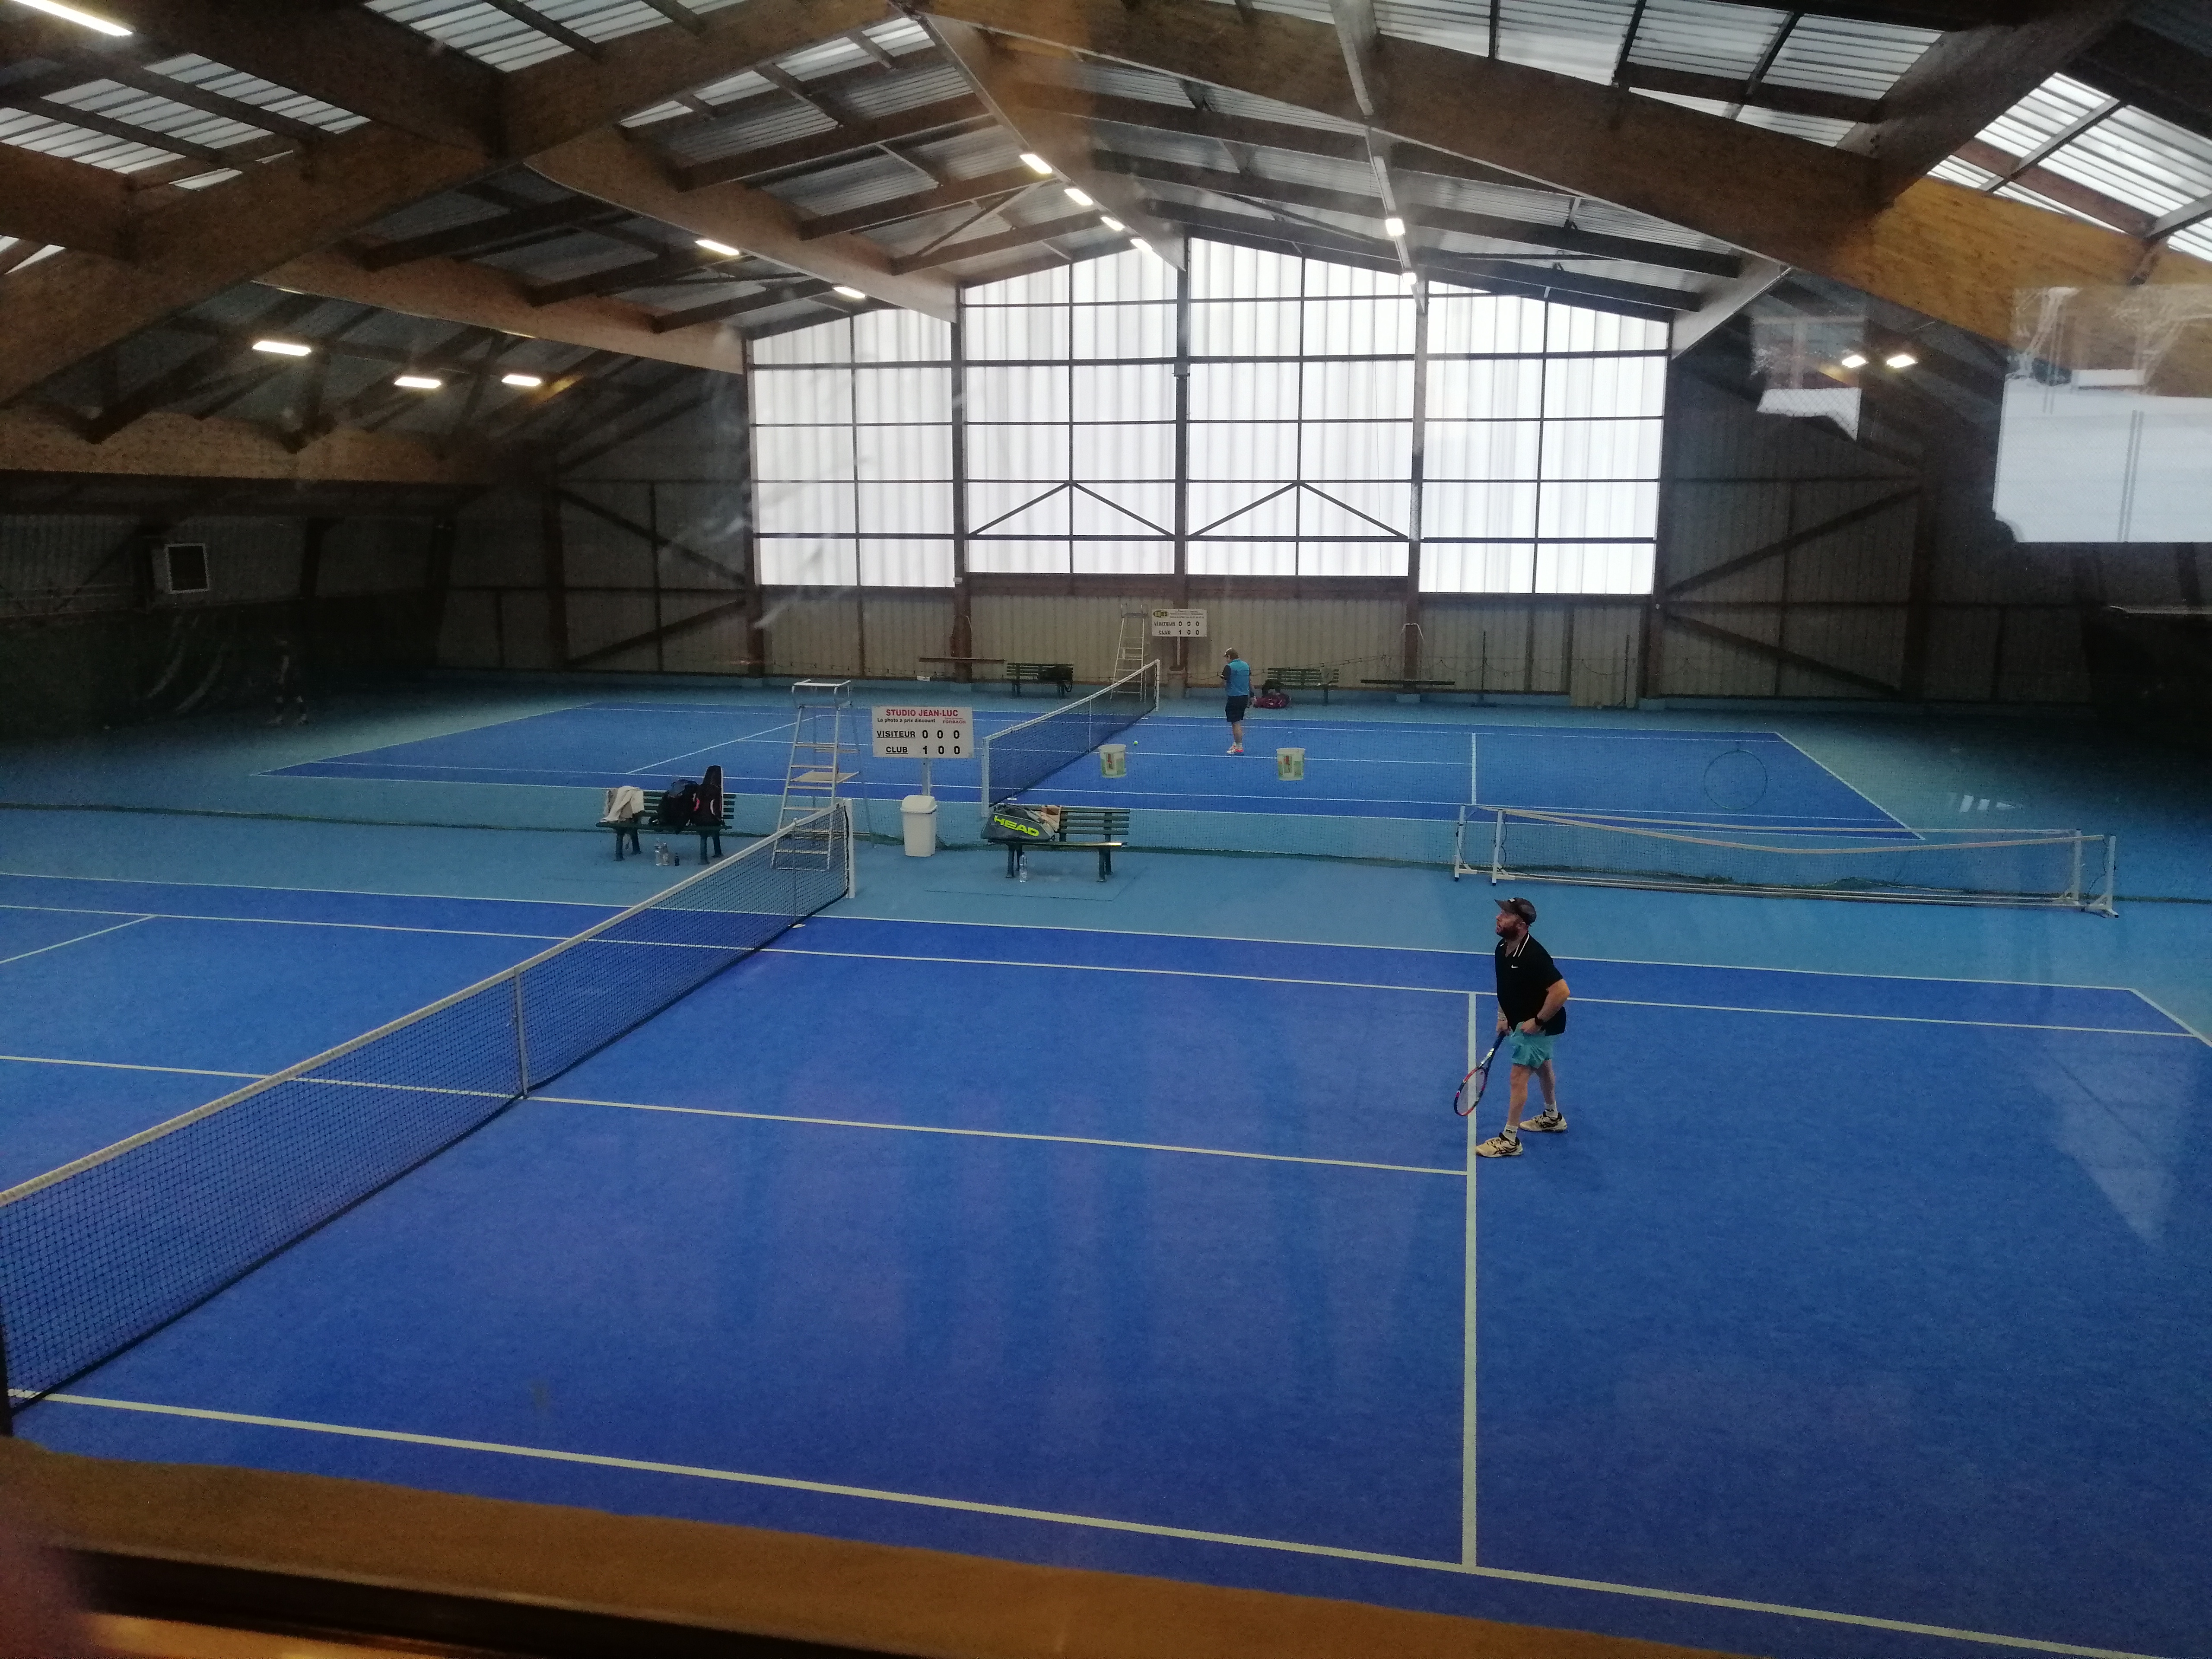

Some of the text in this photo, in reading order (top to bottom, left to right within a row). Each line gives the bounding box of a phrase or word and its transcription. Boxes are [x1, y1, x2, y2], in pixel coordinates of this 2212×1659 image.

[922, 730, 928, 739] 0
[937, 730, 943, 739] 0
[953, 730, 960, 739] 0
[923, 746, 928, 754] 1
[938, 746, 944, 754] 0
[954, 746, 960, 754] 0
[994, 816, 1039, 836] HEAD
